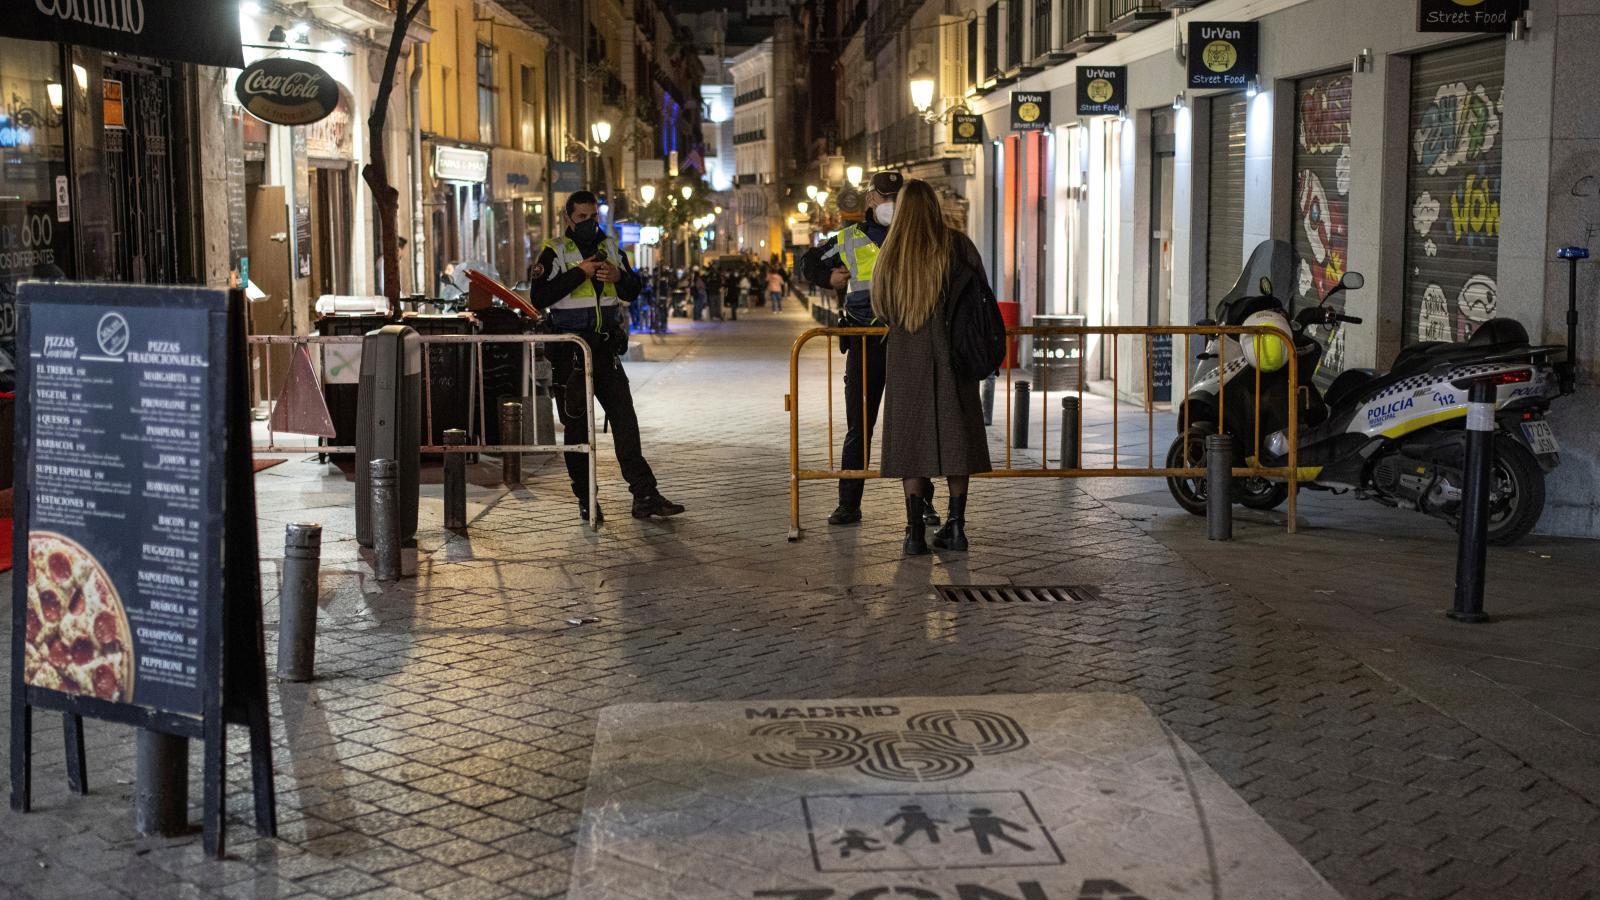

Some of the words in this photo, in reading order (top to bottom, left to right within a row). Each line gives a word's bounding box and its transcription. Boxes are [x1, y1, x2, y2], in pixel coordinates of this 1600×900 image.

[1427, 10, 1470, 24] Street
[1475, 9, 1507, 24] Food
[1201, 27, 1241, 39] UrVan
[1086, 69, 1116, 78] UrVan
[1192, 73, 1222, 84] Street
[1224, 73, 1245, 84] Food
[1018, 95, 1042, 103] UrVan
[22, 214, 52, 247] 600
[13, 248, 55, 268] DIFERENTES
[44, 335, 76, 349] PIZZAS
[147, 341, 181, 353] PIZZAS
[126, 352, 202, 367] TRADICIONALES
[36, 388, 68, 400] VEGETAL
[1438, 393, 1456, 406] 112
[41, 415, 71, 425] QUESOS
[36, 438, 74, 451] BARBACOA
[36, 464, 58, 475] SUPER
[58, 466, 92, 479] ESPECIAL
[41, 495, 84, 508] ESTACIONES
[745, 704, 901, 720] MADRID
[750, 709, 1032, 782] 360
